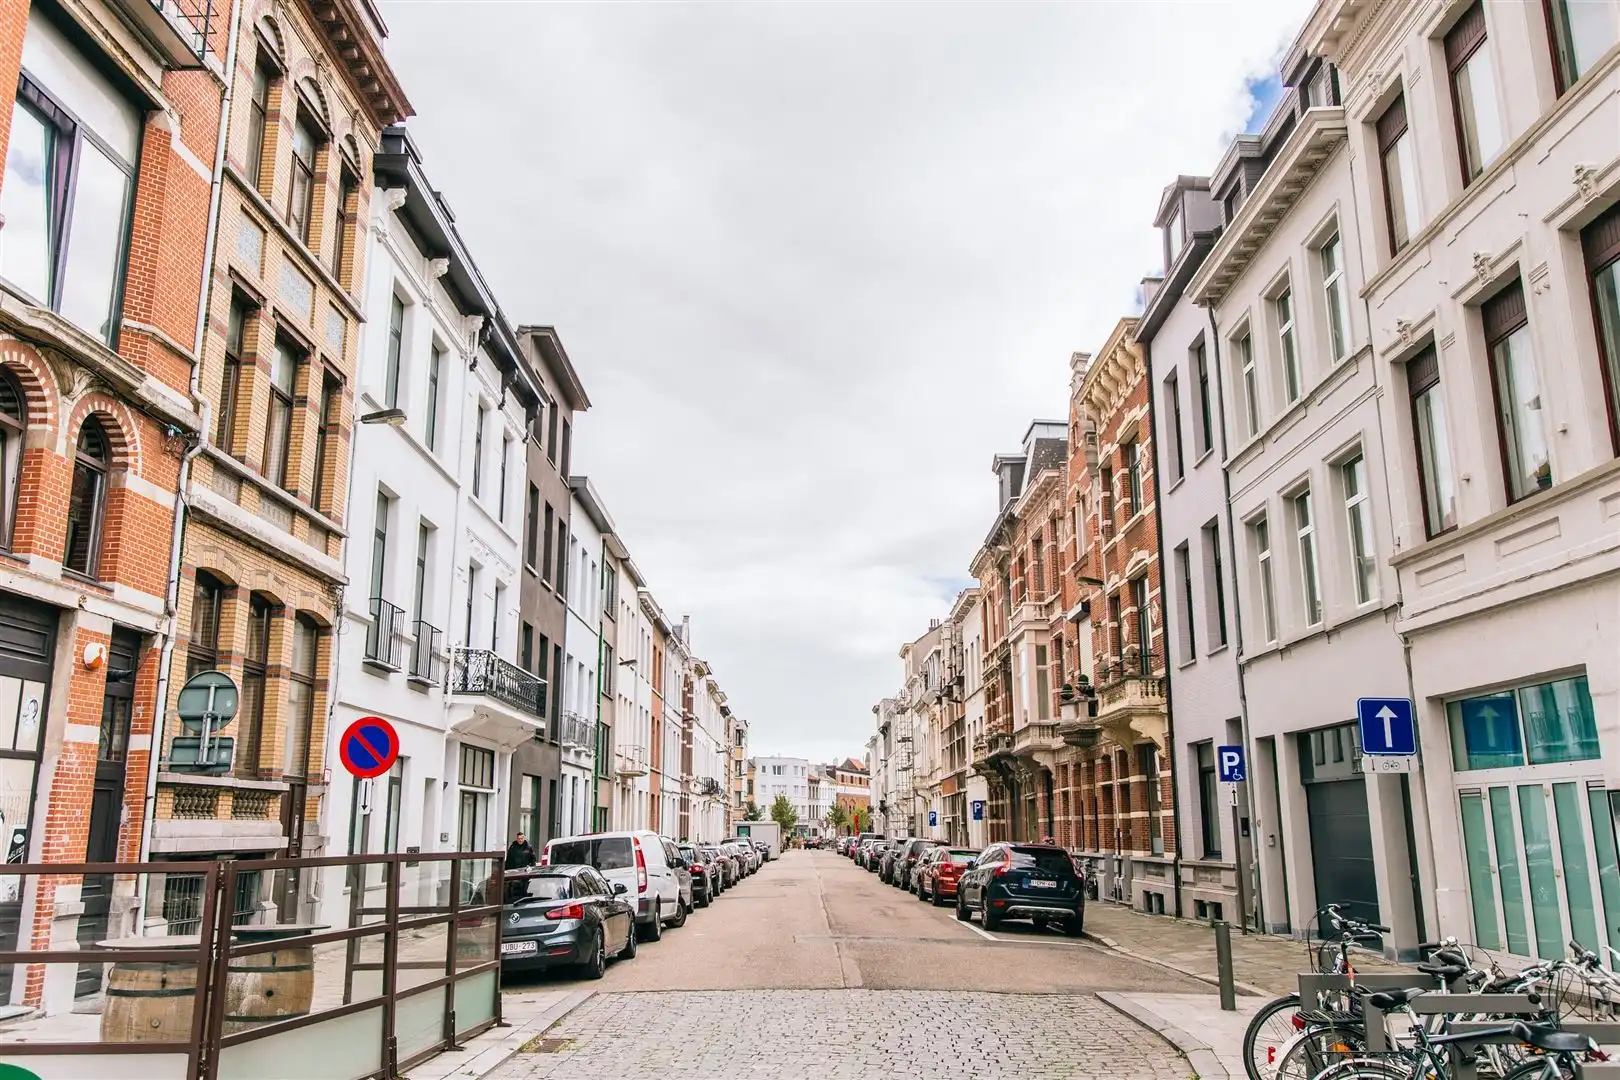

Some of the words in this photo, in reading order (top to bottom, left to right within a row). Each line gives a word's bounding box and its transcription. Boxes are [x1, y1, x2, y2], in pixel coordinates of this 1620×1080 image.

[1222, 751, 1240, 775] P
[974, 802, 982, 813] P
[930, 812, 936, 821] P
